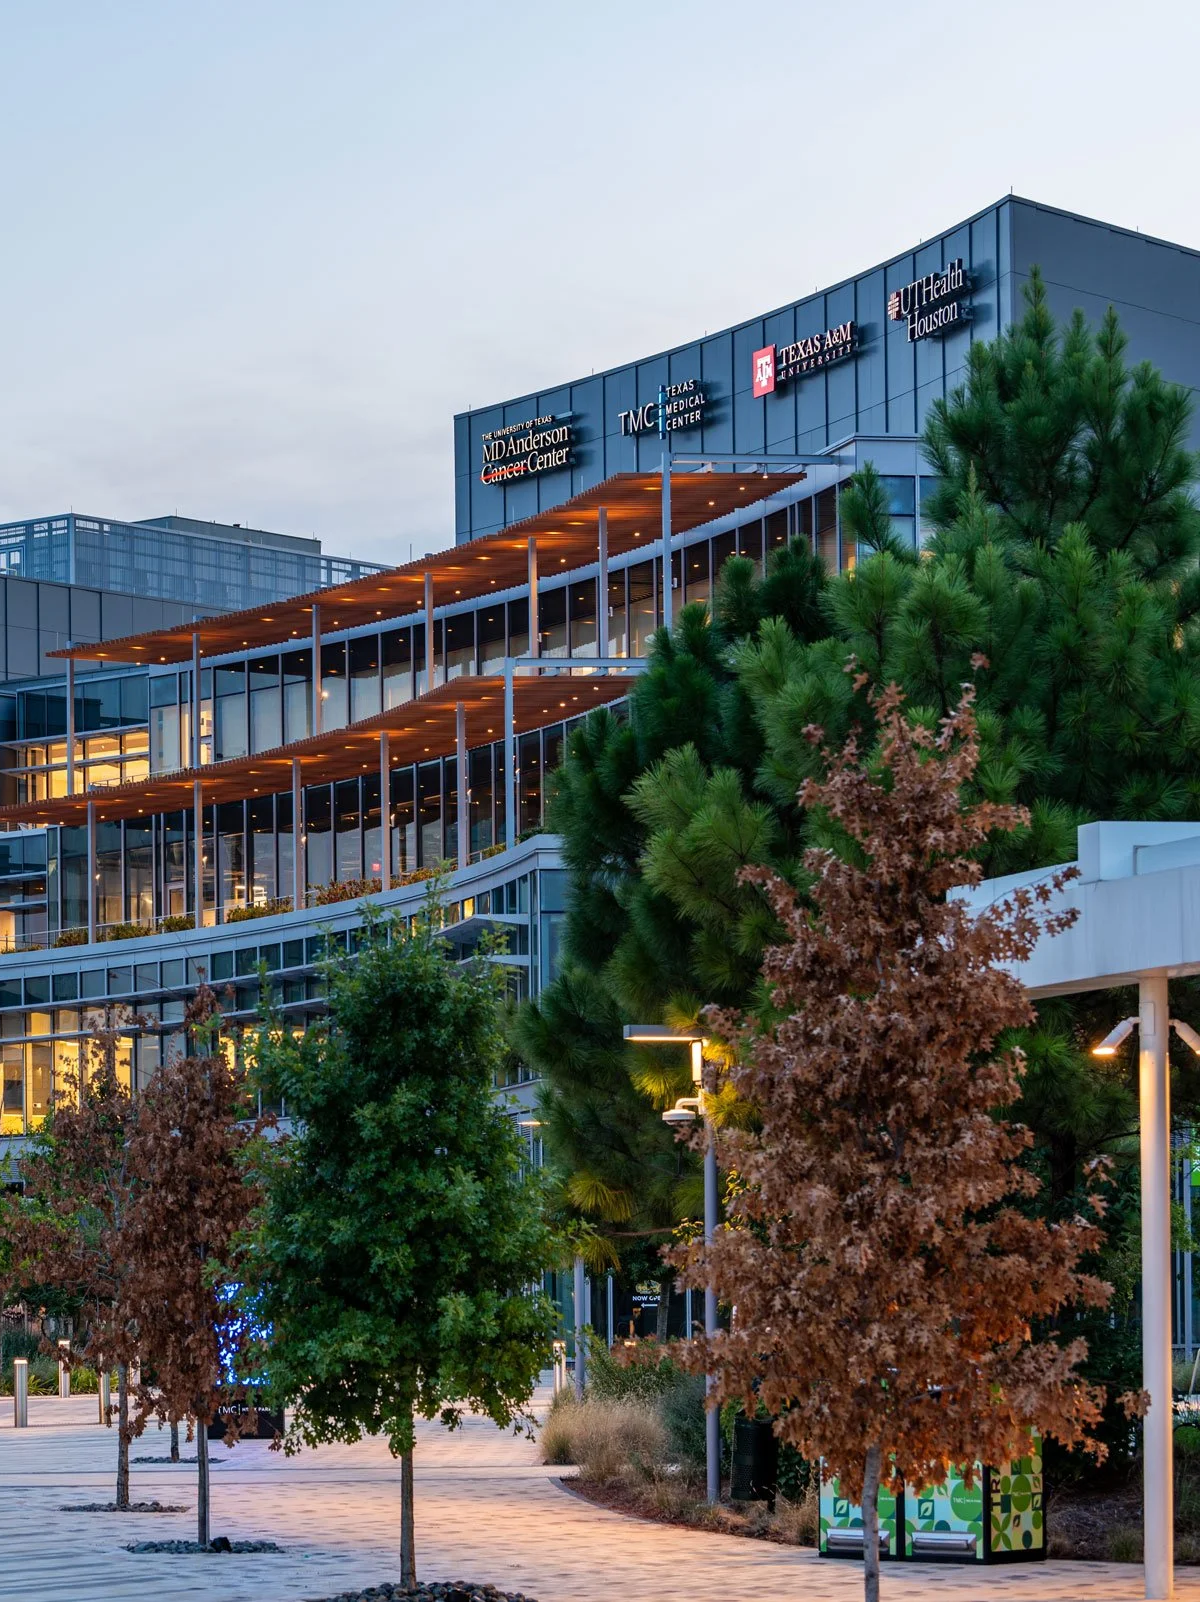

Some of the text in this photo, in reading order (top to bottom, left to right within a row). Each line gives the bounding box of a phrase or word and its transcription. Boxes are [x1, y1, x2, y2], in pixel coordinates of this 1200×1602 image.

[900, 259, 963, 315] UTHealth
[907, 302, 958, 342] Houston
[780, 321, 852, 367] TEXAS A&M
[781, 344, 851, 380] UNIVERSITY
[665, 393, 705, 415] MEDICAL
[666, 380, 694, 398] TEXAS
[481, 414, 552, 441] THE UNIVERSITY OF TEXAS
[618, 402, 654, 436] TMC
[665, 410, 701, 431] CENTER
[482, 425, 568, 464] MD Anderson
[480, 447, 569, 485] Cancer Center
